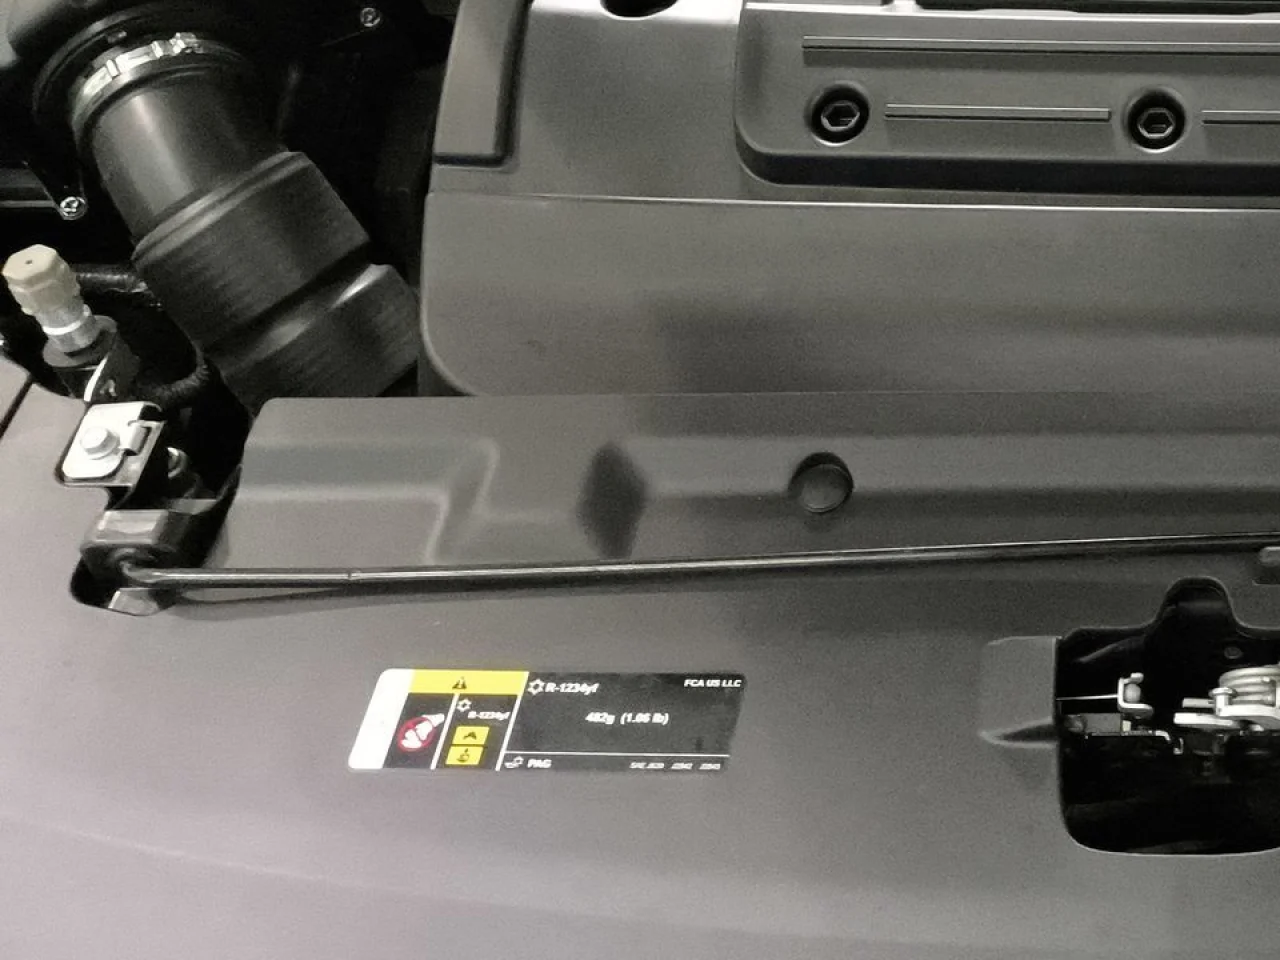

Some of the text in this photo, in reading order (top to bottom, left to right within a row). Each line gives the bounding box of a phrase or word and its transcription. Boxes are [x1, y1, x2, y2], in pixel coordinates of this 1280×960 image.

[545, 682, 599, 696] R-1234yf
[683, 678, 742, 688] FCA US LLC
